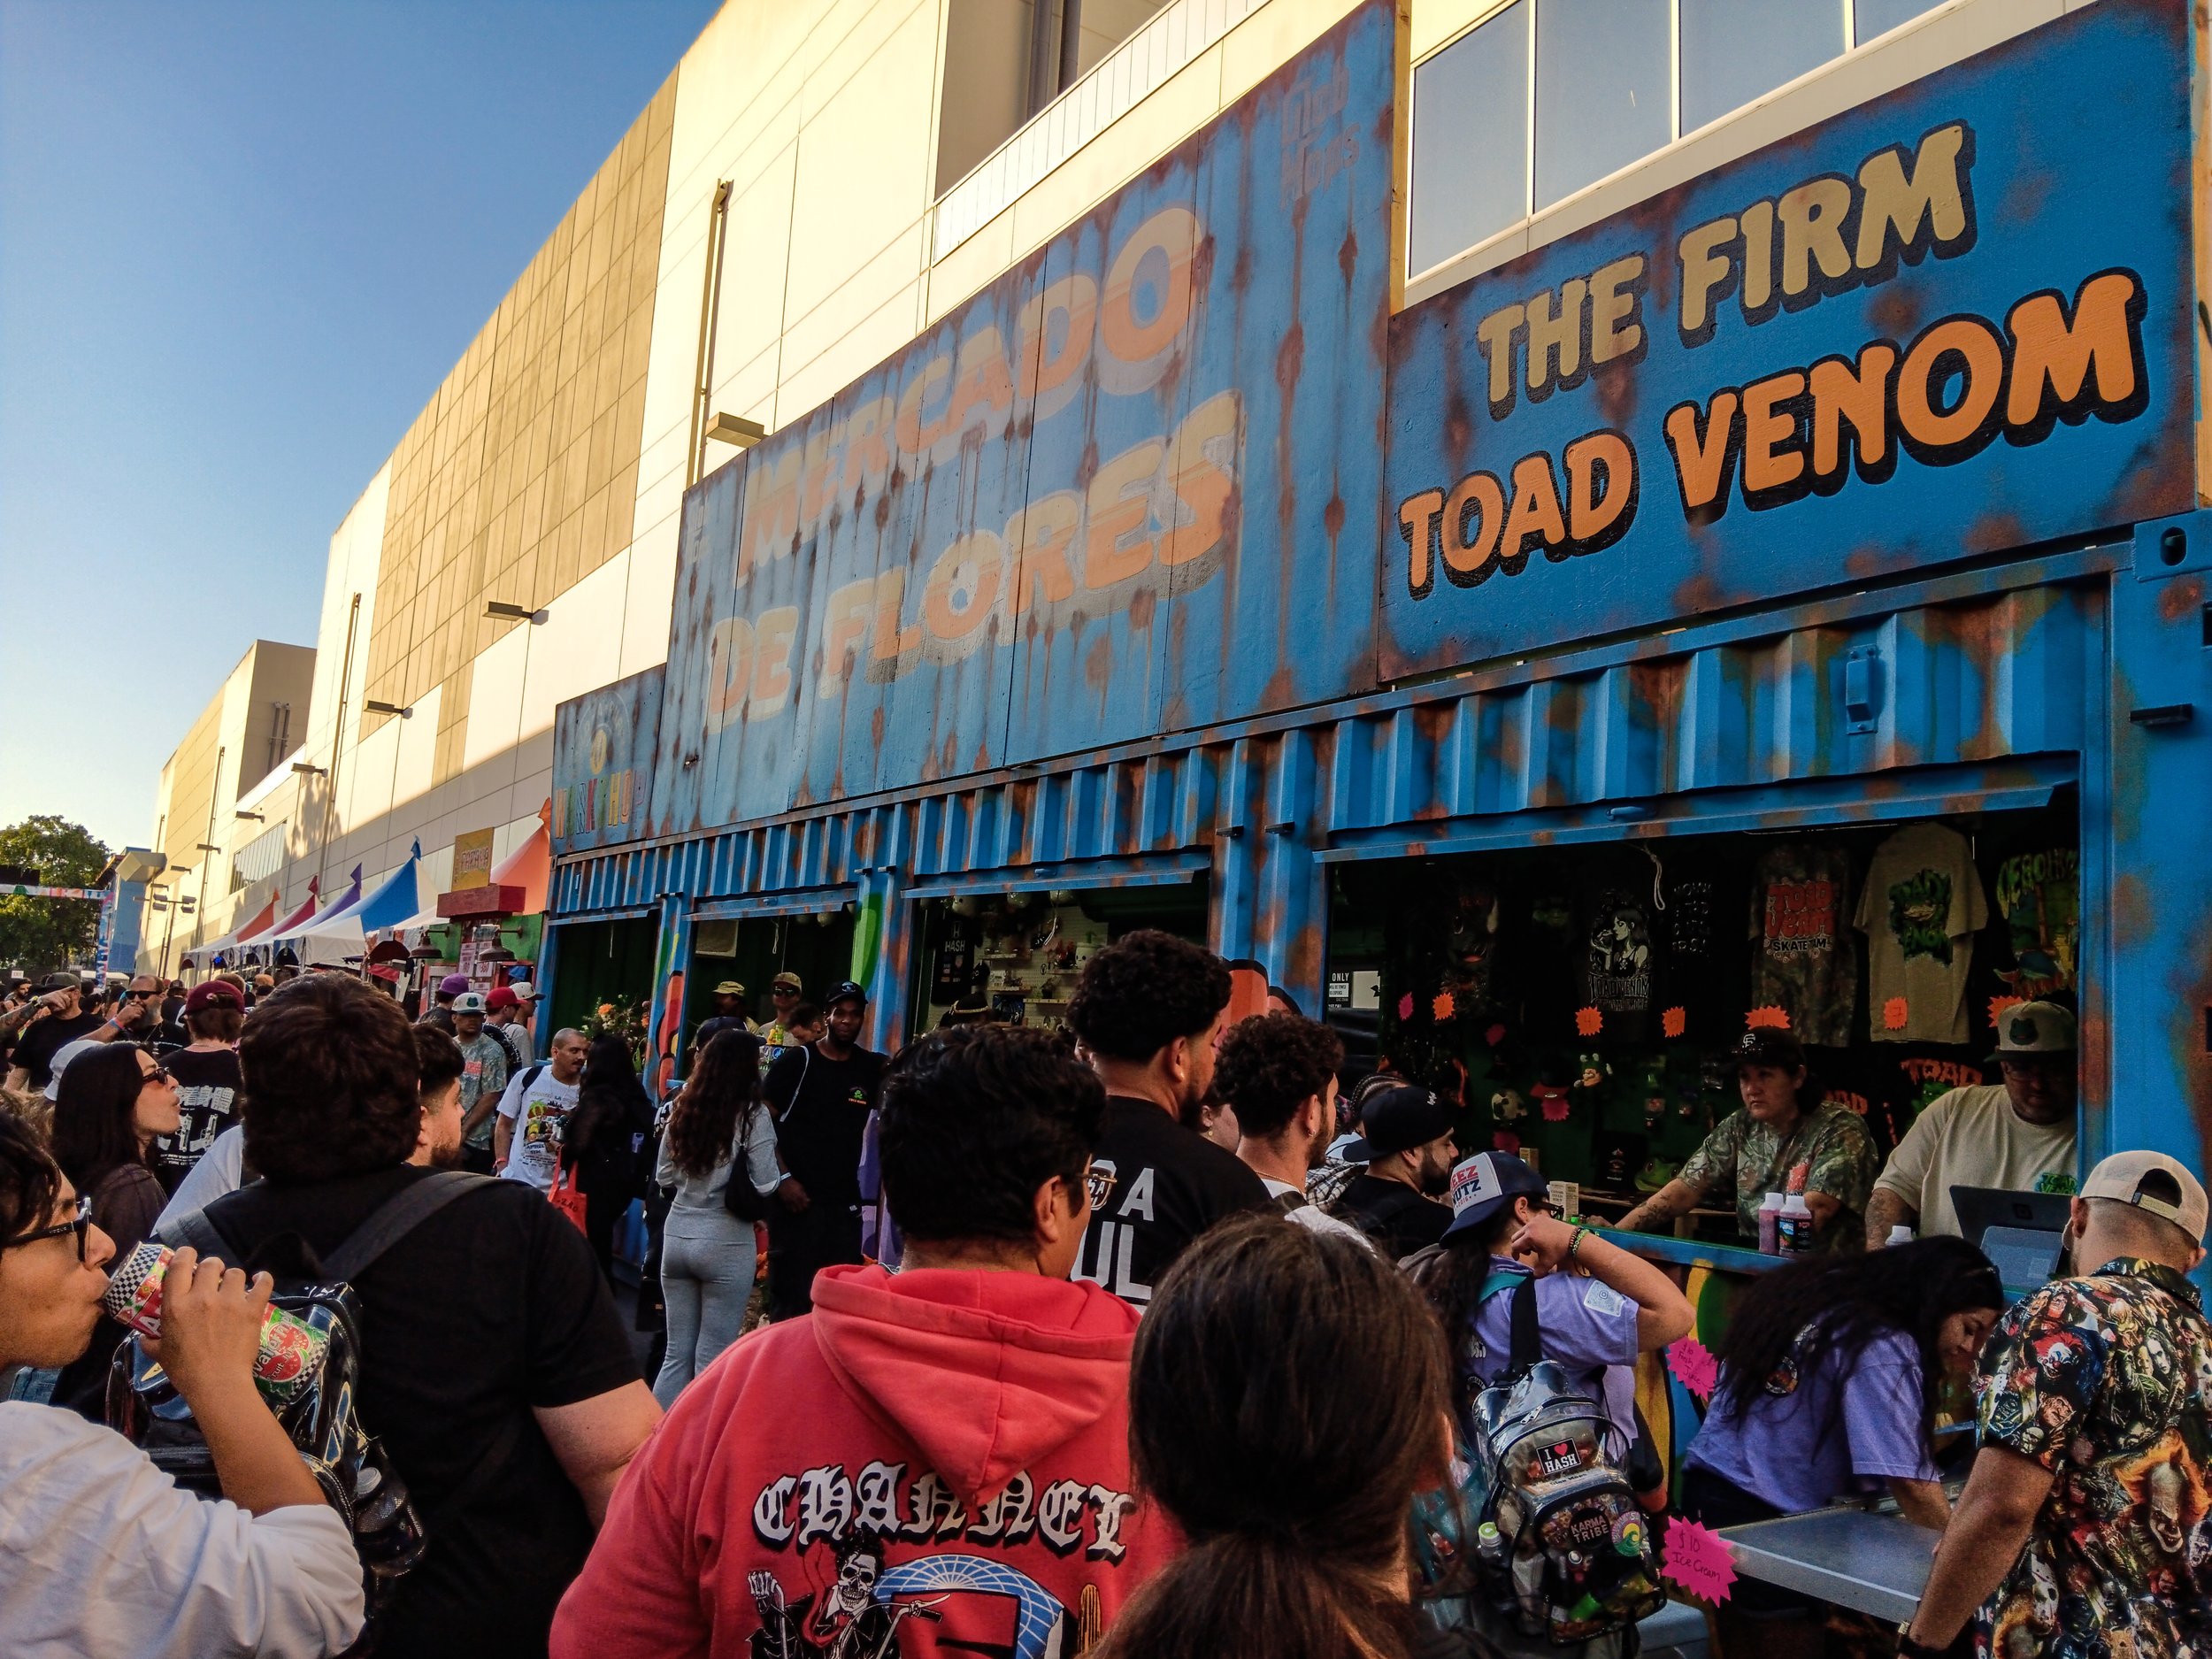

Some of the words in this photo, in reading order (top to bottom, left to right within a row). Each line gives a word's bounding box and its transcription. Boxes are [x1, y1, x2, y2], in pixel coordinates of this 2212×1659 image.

[1478, 253, 1647, 416] THE
[1678, 120, 1974, 343] FIRM
[736, 205, 1205, 586] MERCADO
[1399, 429, 1638, 595] TOAD
[1665, 269, 2145, 520] VENOM
[708, 605, 801, 727] DE
[821, 389, 1246, 690] FLORES
[944, 940, 966, 953] HASH
[1772, 940, 1808, 952] SKATE
[1332, 972, 1349, 982] ONLY
[1899, 1056, 1983, 1087] TOAD
[1451, 1164, 1479, 1187] EEZ
[1544, 1449, 1552, 1460] I
[1544, 1453, 1578, 1473] HASH
[1570, 1515, 1607, 1535] KARMA
[1573, 1524, 1609, 1544] TRIBE
[1671, 1552, 1692, 1567] Ice
[1693, 1559, 1721, 1582] Cream
